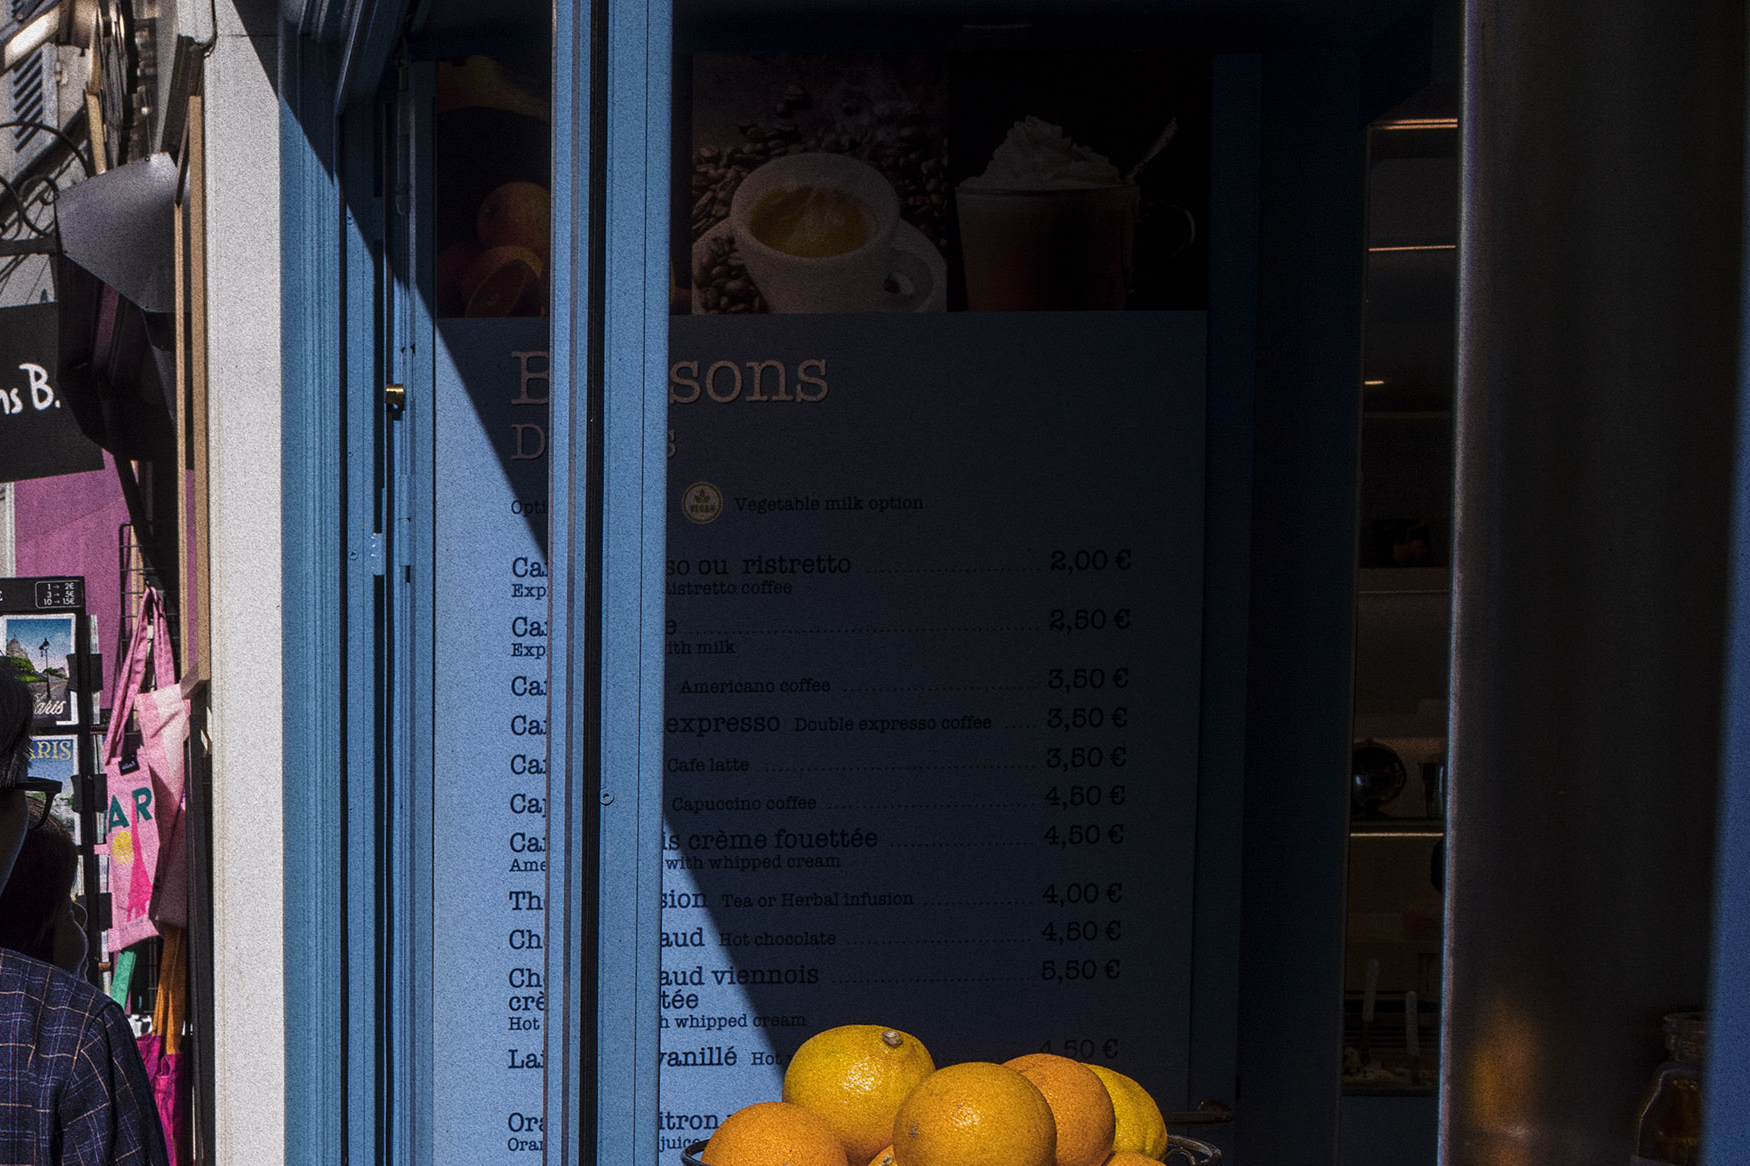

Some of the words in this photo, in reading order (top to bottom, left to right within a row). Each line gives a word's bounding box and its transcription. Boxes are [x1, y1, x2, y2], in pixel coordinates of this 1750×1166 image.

[18, 361, 61, 411] B.
[511, 499, 548, 517] Opti
[735, 496, 819, 514] Vegetable
[825, 496, 863, 511] milk
[869, 496, 924, 513] option
[512, 556, 548, 578] Ca
[698, 559, 729, 576] ou
[742, 555, 850, 576] ristretto
[1051, 550, 1107, 575] 2,00
[1116, 549, 1132, 570] €
[511, 584, 547, 601] Exp
[741, 580, 792, 595] coffee
[512, 616, 548, 638] Ca
[1050, 609, 1106, 634] 2,50
[1114, 608, 1130, 630] €
[511, 643, 546, 659] Exp
[666, 640, 692, 655] ith
[696, 640, 737, 655] milk
[511, 676, 547, 697] Ca
[681, 679, 775, 695] Americano
[779, 679, 831, 693] coffee
[1048, 668, 1105, 693] 3,50
[1113, 667, 1129, 688] €
[511, 715, 547, 736] Ca
[665, 715, 780, 737] expresso
[795, 716, 854, 732] Double
[859, 717, 936, 733] expresso
[941, 715, 992, 730] coffee
[1047, 707, 1104, 732] 3,50
[1113, 707, 1128, 728] €
[510, 754, 546, 775] Ca
[667, 757, 705, 772] Cafe
[710, 756, 750, 772] latte
[1047, 747, 1103, 772] 3,50
[1110, 747, 1126, 767] €
[672, 797, 761, 812] Capuccino
[766, 796, 817, 811] coffee
[1046, 786, 1101, 810] 4,50
[1109, 785, 1125, 805] €
[510, 832, 546, 853] Ca
[689, 829, 768, 850] crème
[775, 828, 878, 849] fouettée
[1044, 824, 1100, 849] 4,50
[1107, 823, 1124, 844] €
[509, 859, 546, 872] Ame
[666, 856, 703, 871] with
[708, 855, 782, 872] whipped
[787, 855, 841, 869] cream
[509, 890, 544, 911] Th
[661, 889, 708, 909] sion
[722, 894, 754, 908] Tea
[758, 895, 776, 908] or
[783, 892, 838, 907] Herbal
[843, 891, 914, 906] infusion
[1042, 883, 1099, 908] 4,00
[1106, 882, 1122, 903] €
[509, 929, 544, 950] Ch
[661, 927, 705, 947] aud
[719, 932, 749, 947] Hot
[754, 931, 837, 946] chocolate
[1042, 921, 1098, 946] 4,50
[1105, 920, 1121, 941] €
[509, 968, 544, 988] Ch
[661, 966, 704, 986] aud
[712, 965, 819, 985] viennois
[1042, 960, 1097, 985] 5,50
[1104, 959, 1120, 980] €
[509, 990, 545, 1011] crè
[662, 989, 699, 1009] tée
[508, 1016, 540, 1031] Hot
[674, 1013, 748, 1031] whipped
[753, 1014, 807, 1028] cream
[508, 1050, 544, 1069] La
[751, 1051, 781, 1065] Hot
[1040, 1038, 1096, 1059] 450
[1102, 1038, 1118, 1059] €
[659, 1110, 719, 1131] itron
[508, 1137, 544, 1151] Ora
